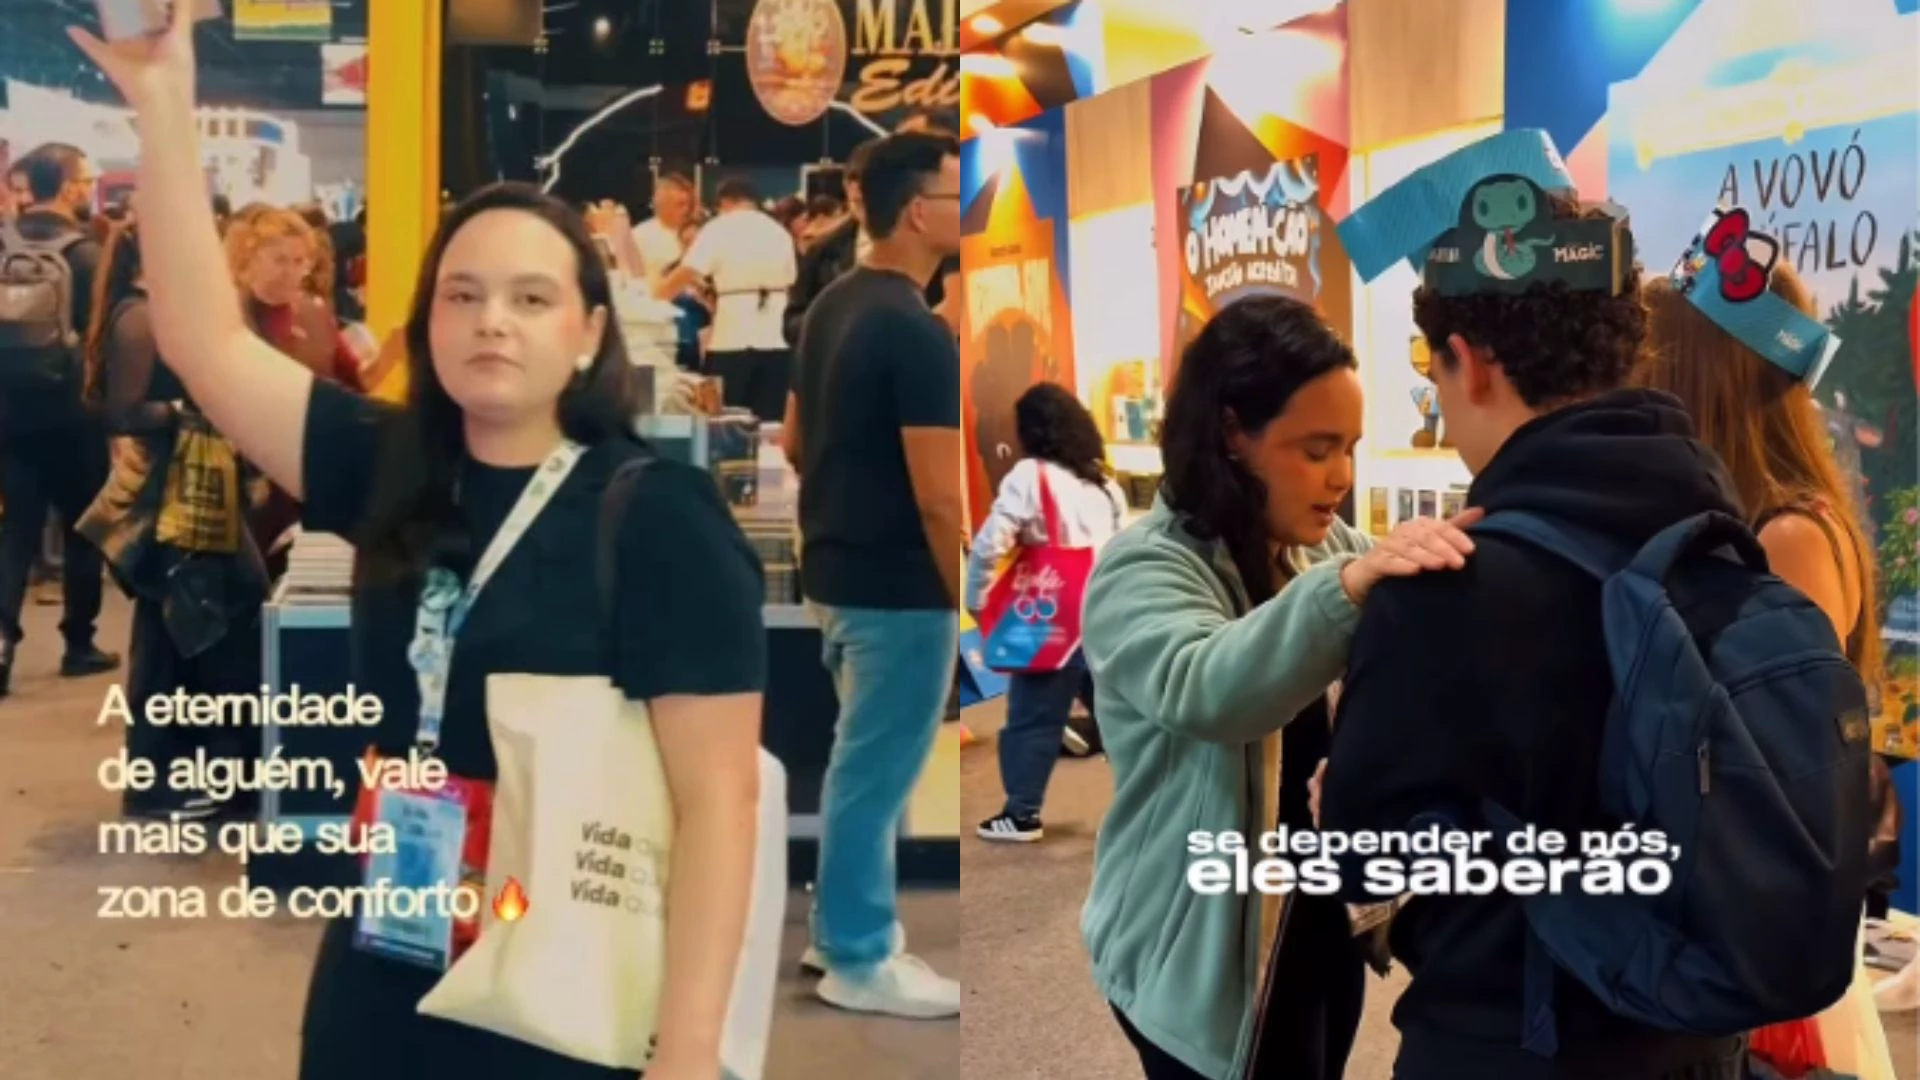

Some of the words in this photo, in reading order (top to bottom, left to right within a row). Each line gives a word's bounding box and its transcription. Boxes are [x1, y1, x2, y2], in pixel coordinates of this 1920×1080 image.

[1718, 163, 1739, 206] A
[1754, 127, 1866, 210] VOVÓ
[1185, 230, 1200, 276] O
[581, 820, 632, 851] Vida
[575, 848, 625, 880] Vida
[569, 877, 621, 909] Vida
